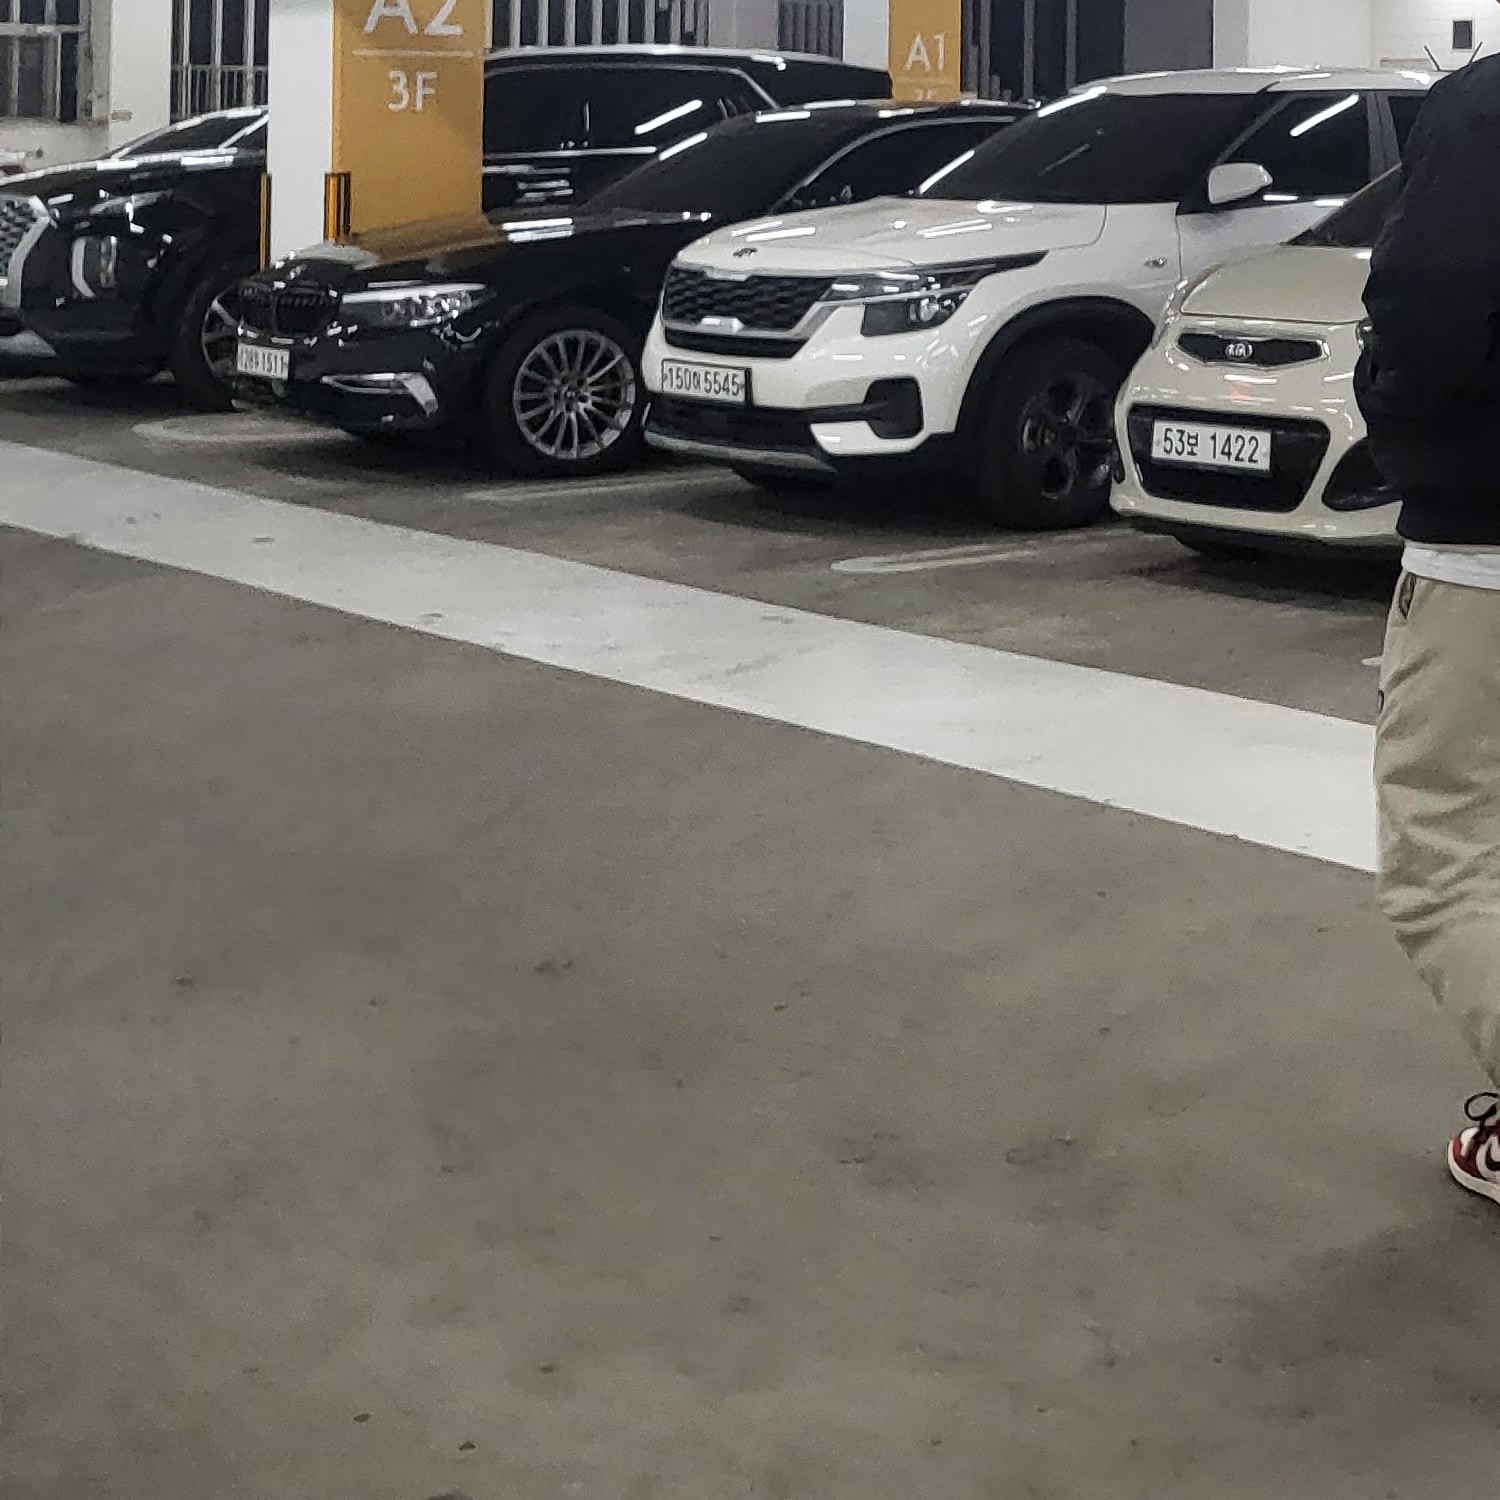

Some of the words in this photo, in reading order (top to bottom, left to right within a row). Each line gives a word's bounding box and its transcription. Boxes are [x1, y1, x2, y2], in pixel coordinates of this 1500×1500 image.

[904, 32, 945, 72] A1
[387, 69, 438, 112] 3F
[703, 370, 740, 397] 5545
[1162, 426, 1200, 457] 53보
[1209, 431, 1260, 464] 1422
